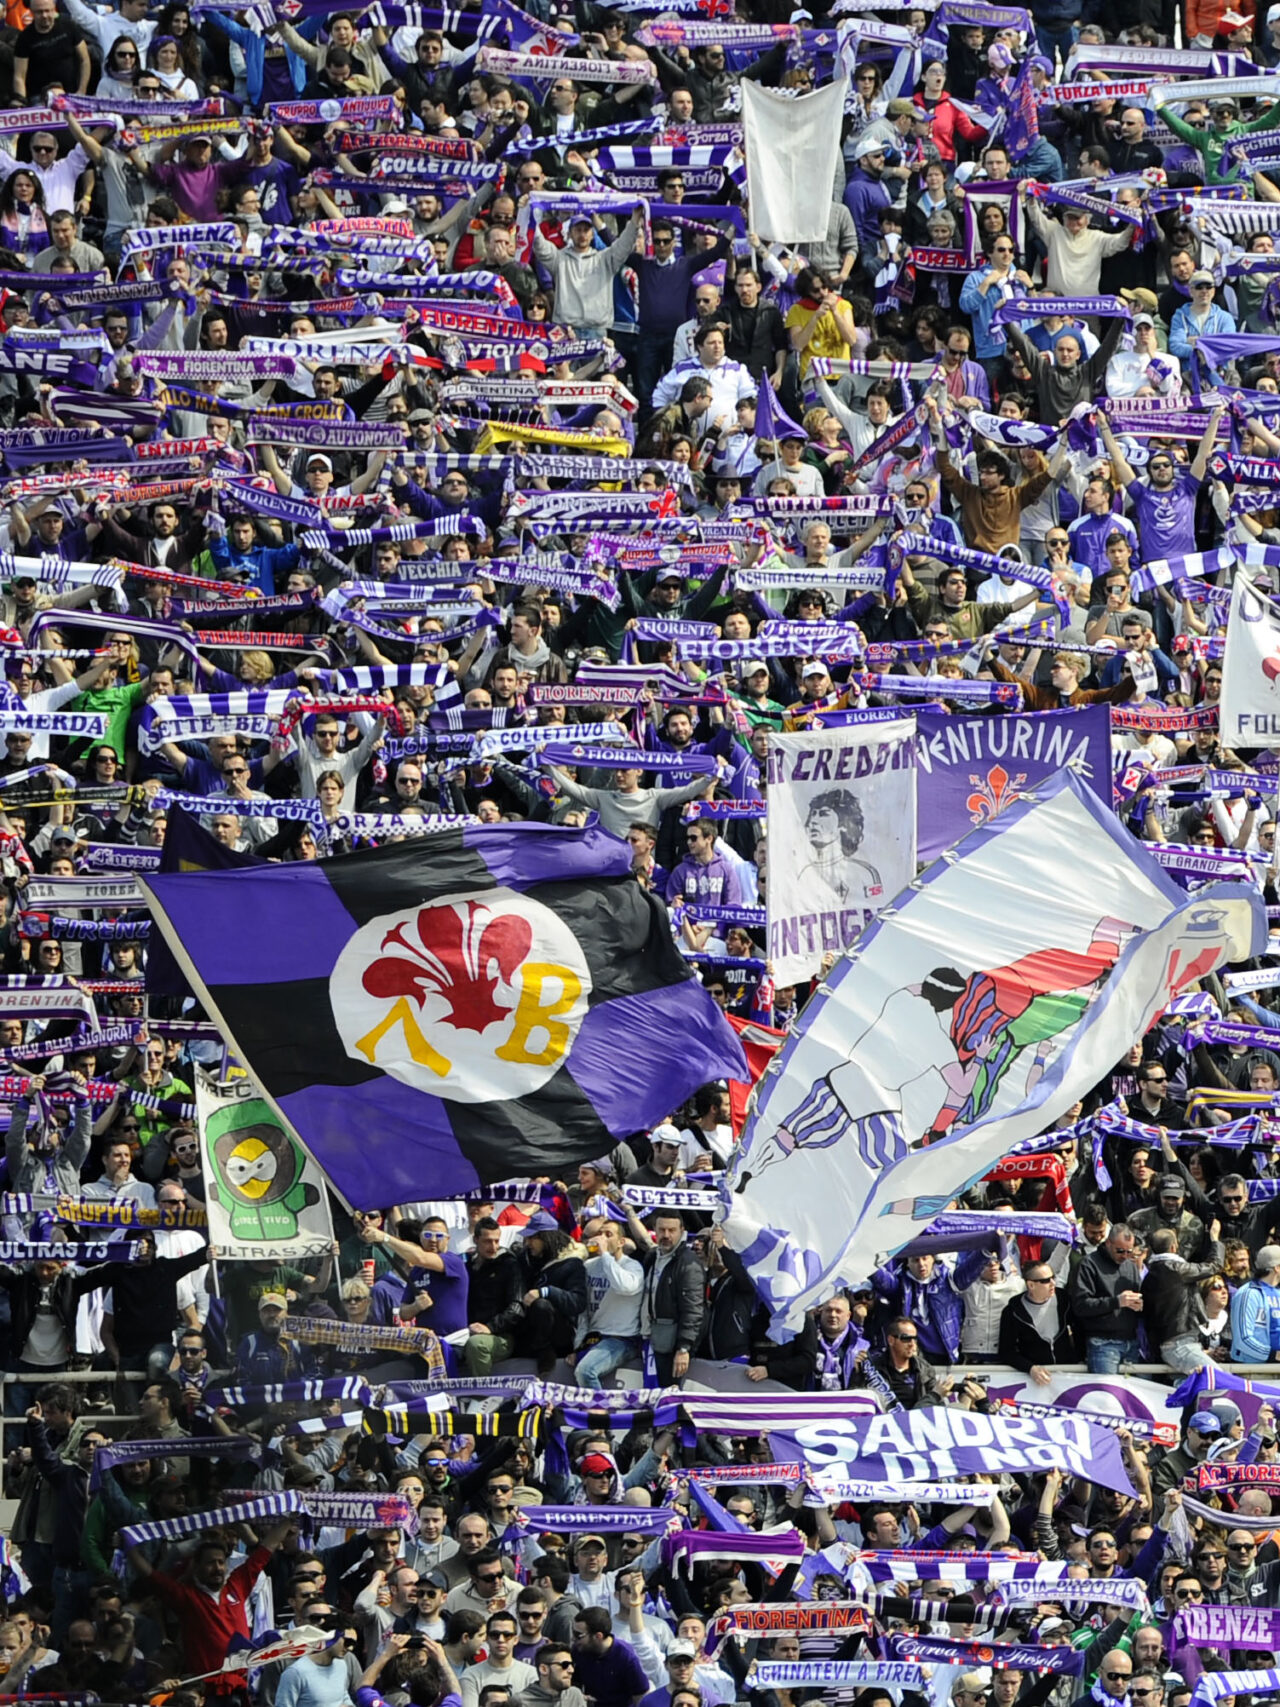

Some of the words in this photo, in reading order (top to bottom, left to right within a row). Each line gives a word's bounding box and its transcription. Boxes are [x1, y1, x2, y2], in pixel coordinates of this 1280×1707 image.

[685, 24, 772, 39] FIORENTINA
[1055, 83, 1097, 100] FORZA
[1103, 80, 1148, 98] VIOLA
[381, 158, 498, 178] COLLETTIVO
[1030, 299, 1124, 313] FIORENTINA
[423, 309, 546, 339] FIORENTINA
[169, 360, 179, 371] la
[185, 358, 255, 373] FIORENTINA
[445, 385, 538, 399] FIORENTINA
[234, 486, 321, 527] FIORENTINA
[536, 495, 648, 514] FIORENTINA
[756, 498, 823, 513] GRUPPO
[847, 497, 892, 511] ROMA
[400, 564, 461, 580] VECCHIA
[514, 567, 581, 587] FIORENTINA
[681, 637, 861, 660] FIORENZA
[535, 685, 644, 701] FIORENTINA
[14, 715, 102, 734] MERDA
[500, 723, 605, 747] COLLETTIVO
[917, 717, 1090, 775] VENTURINA
[587, 749, 684, 765] FIORENTINA
[1176, 858, 1224, 872] GRANDE
[514, 963, 583, 1066] B
[78, 1025, 134, 1046] SIGNORA!
[1208, 1021, 1256, 1041] Firenze
[625, 1186, 704, 1208] SETTE
[85, 1243, 108, 1259] 73
[794, 1406, 1096, 1464] SANDRO
[881, 1452, 959, 1482] DI
[979, 1442, 1093, 1480] NOI
[545, 1511, 653, 1527] FIORENTINA
[733, 1607, 864, 1629] FIORENTINA
[1174, 1607, 1273, 1645] FIRENZE
[893, 1637, 959, 1658] Curva
[1002, 1643, 1065, 1668] Fiesole
[856, 1661, 869, 1681] A
[1227, 1670, 1272, 1692] NON
